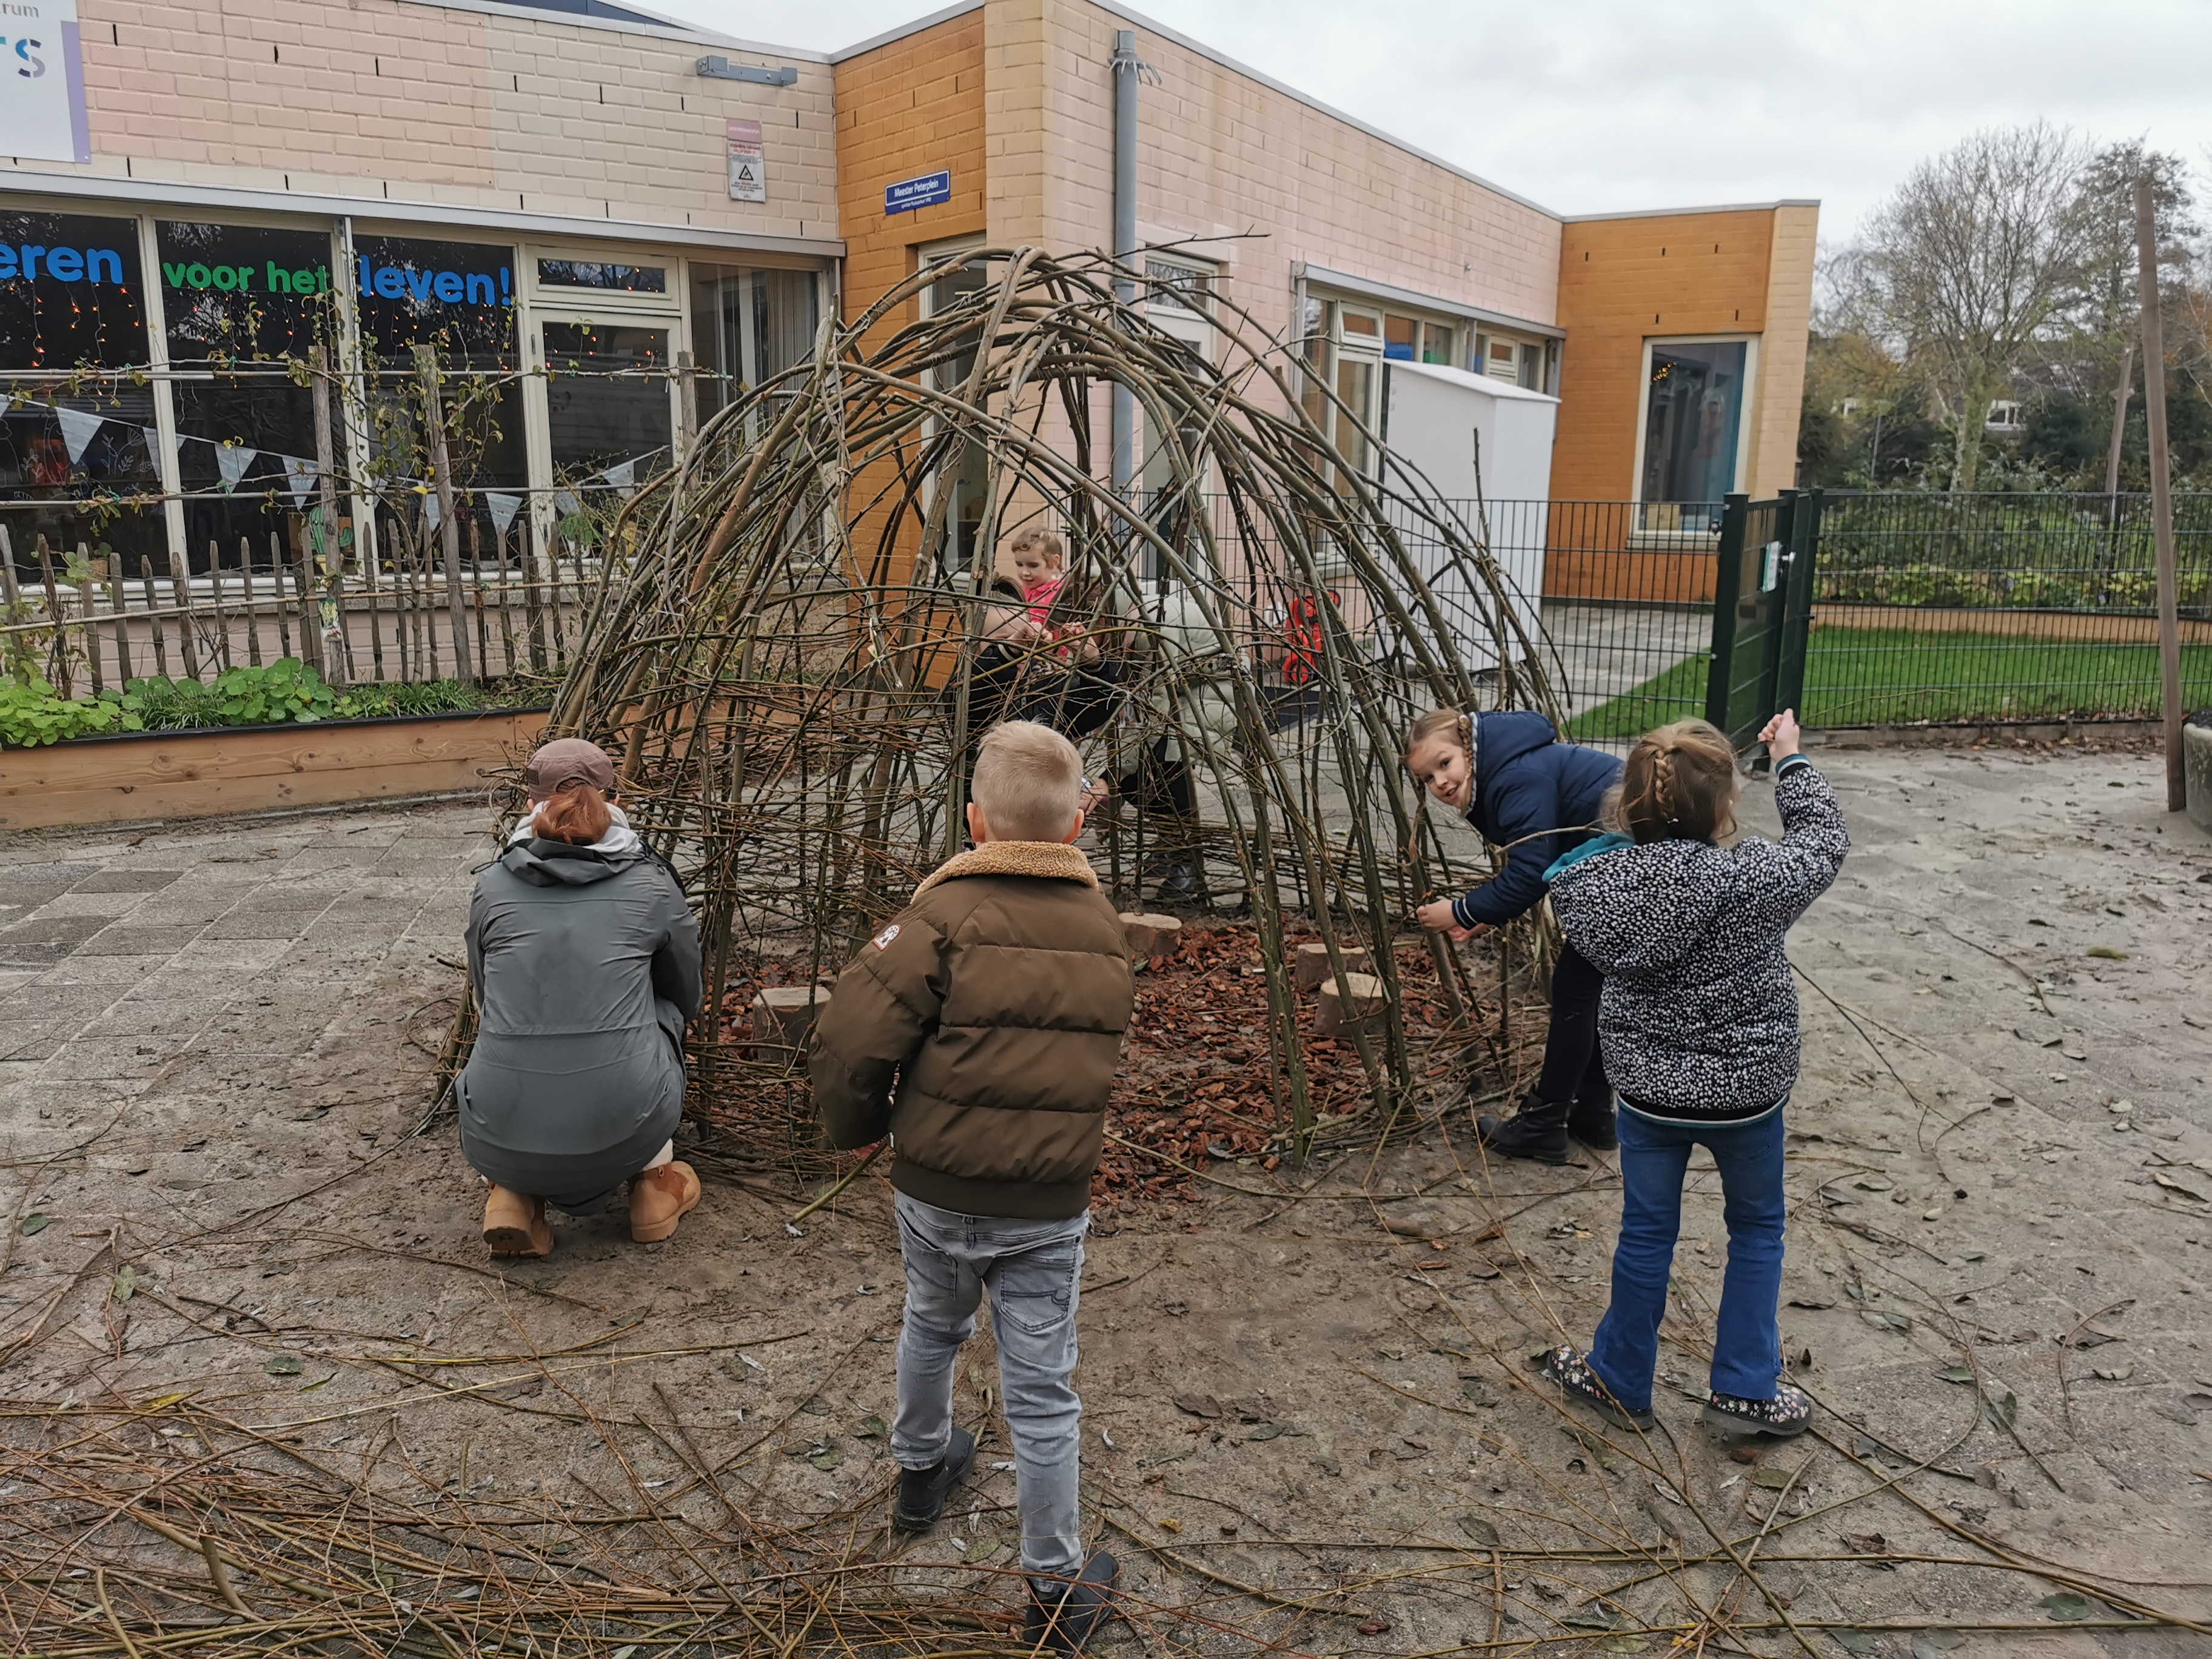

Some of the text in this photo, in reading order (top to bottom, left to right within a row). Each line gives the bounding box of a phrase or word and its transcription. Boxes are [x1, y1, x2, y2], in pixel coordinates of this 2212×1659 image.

[0, 2, 39, 18] rum
[163, 262, 255, 292] voor
[266, 260, 330, 295] het
[359, 254, 511, 306] leven!
